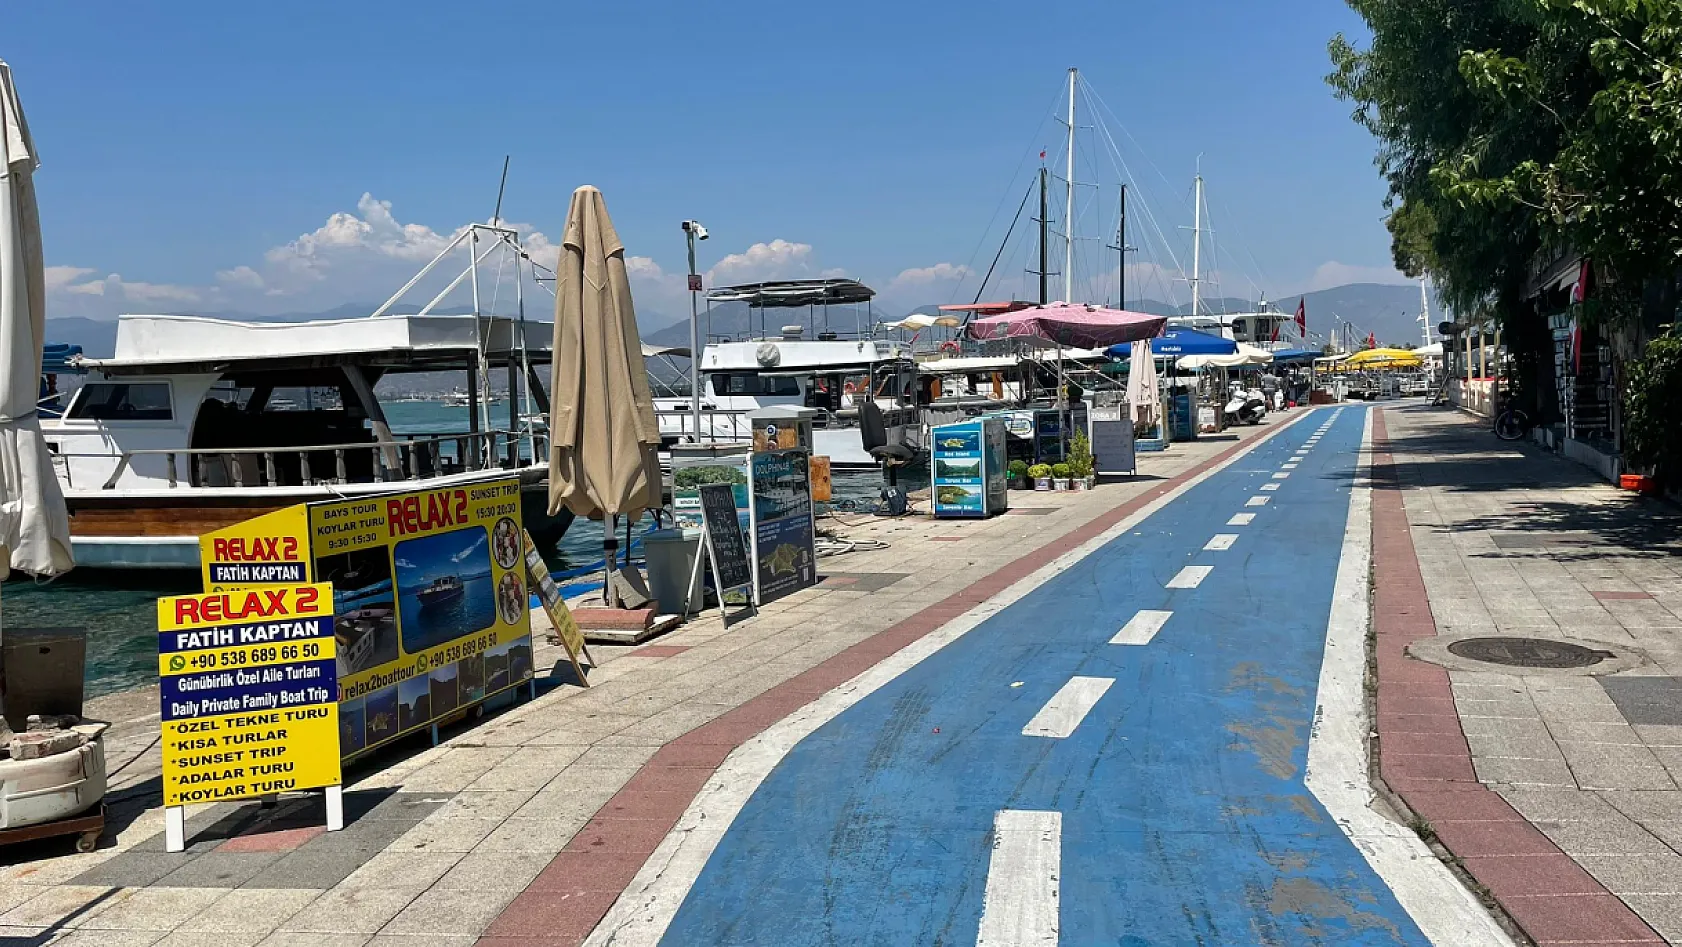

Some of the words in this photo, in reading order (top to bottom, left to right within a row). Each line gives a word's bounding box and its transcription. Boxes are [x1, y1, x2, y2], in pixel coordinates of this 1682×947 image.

[470, 487, 500, 500] SUNSET
[324, 508, 349, 520] BAYS
[352, 504, 377, 514] TOUR
[386, 492, 454, 537] RELAX
[454, 490, 468, 524] 2
[476, 508, 495, 519] 15:30
[497, 503, 516, 516] 20:30
[318, 522, 357, 536] KOYLAR
[360, 517, 385, 528] TURU
[214, 538, 280, 561] RELAX
[283, 536, 298, 560] 2
[328, 538, 349, 549] 9:30
[352, 532, 377, 544] 15:30
[216, 564, 250, 580] FATİH
[252, 566, 299, 580] KAPTAN
[175, 590, 289, 624] RELAX
[296, 587, 318, 614] 2
[177, 626, 233, 650] FATİH
[240, 620, 319, 643] KAPTAN
[190, 652, 216, 669] +90
[220, 650, 247, 666] 538
[252, 647, 276, 663] 689
[281, 644, 298, 660] 66
[302, 642, 319, 658] 50
[430, 651, 444, 667] +90
[446, 646, 460, 662] 538
[462, 640, 476, 656] 689
[478, 636, 486, 650] 66
[488, 632, 497, 646] 50
[178, 673, 235, 692] Günübirlik
[237, 669, 260, 686] Özel
[262, 667, 283, 683] Aile
[285, 665, 320, 680] Turları
[344, 665, 415, 700] relax2boattour
[172, 701, 199, 718] Daily
[202, 698, 240, 714] Private
[242, 694, 278, 711] Family
[280, 690, 305, 705] Boat
[307, 686, 329, 703] Trip
[225, 711, 280, 729] TEKNE
[284, 708, 329, 722] TURU
[222, 729, 288, 746] TURLAR
[249, 746, 287, 760] TRIP
[249, 762, 294, 776] TURU
[250, 778, 296, 794] TURU
